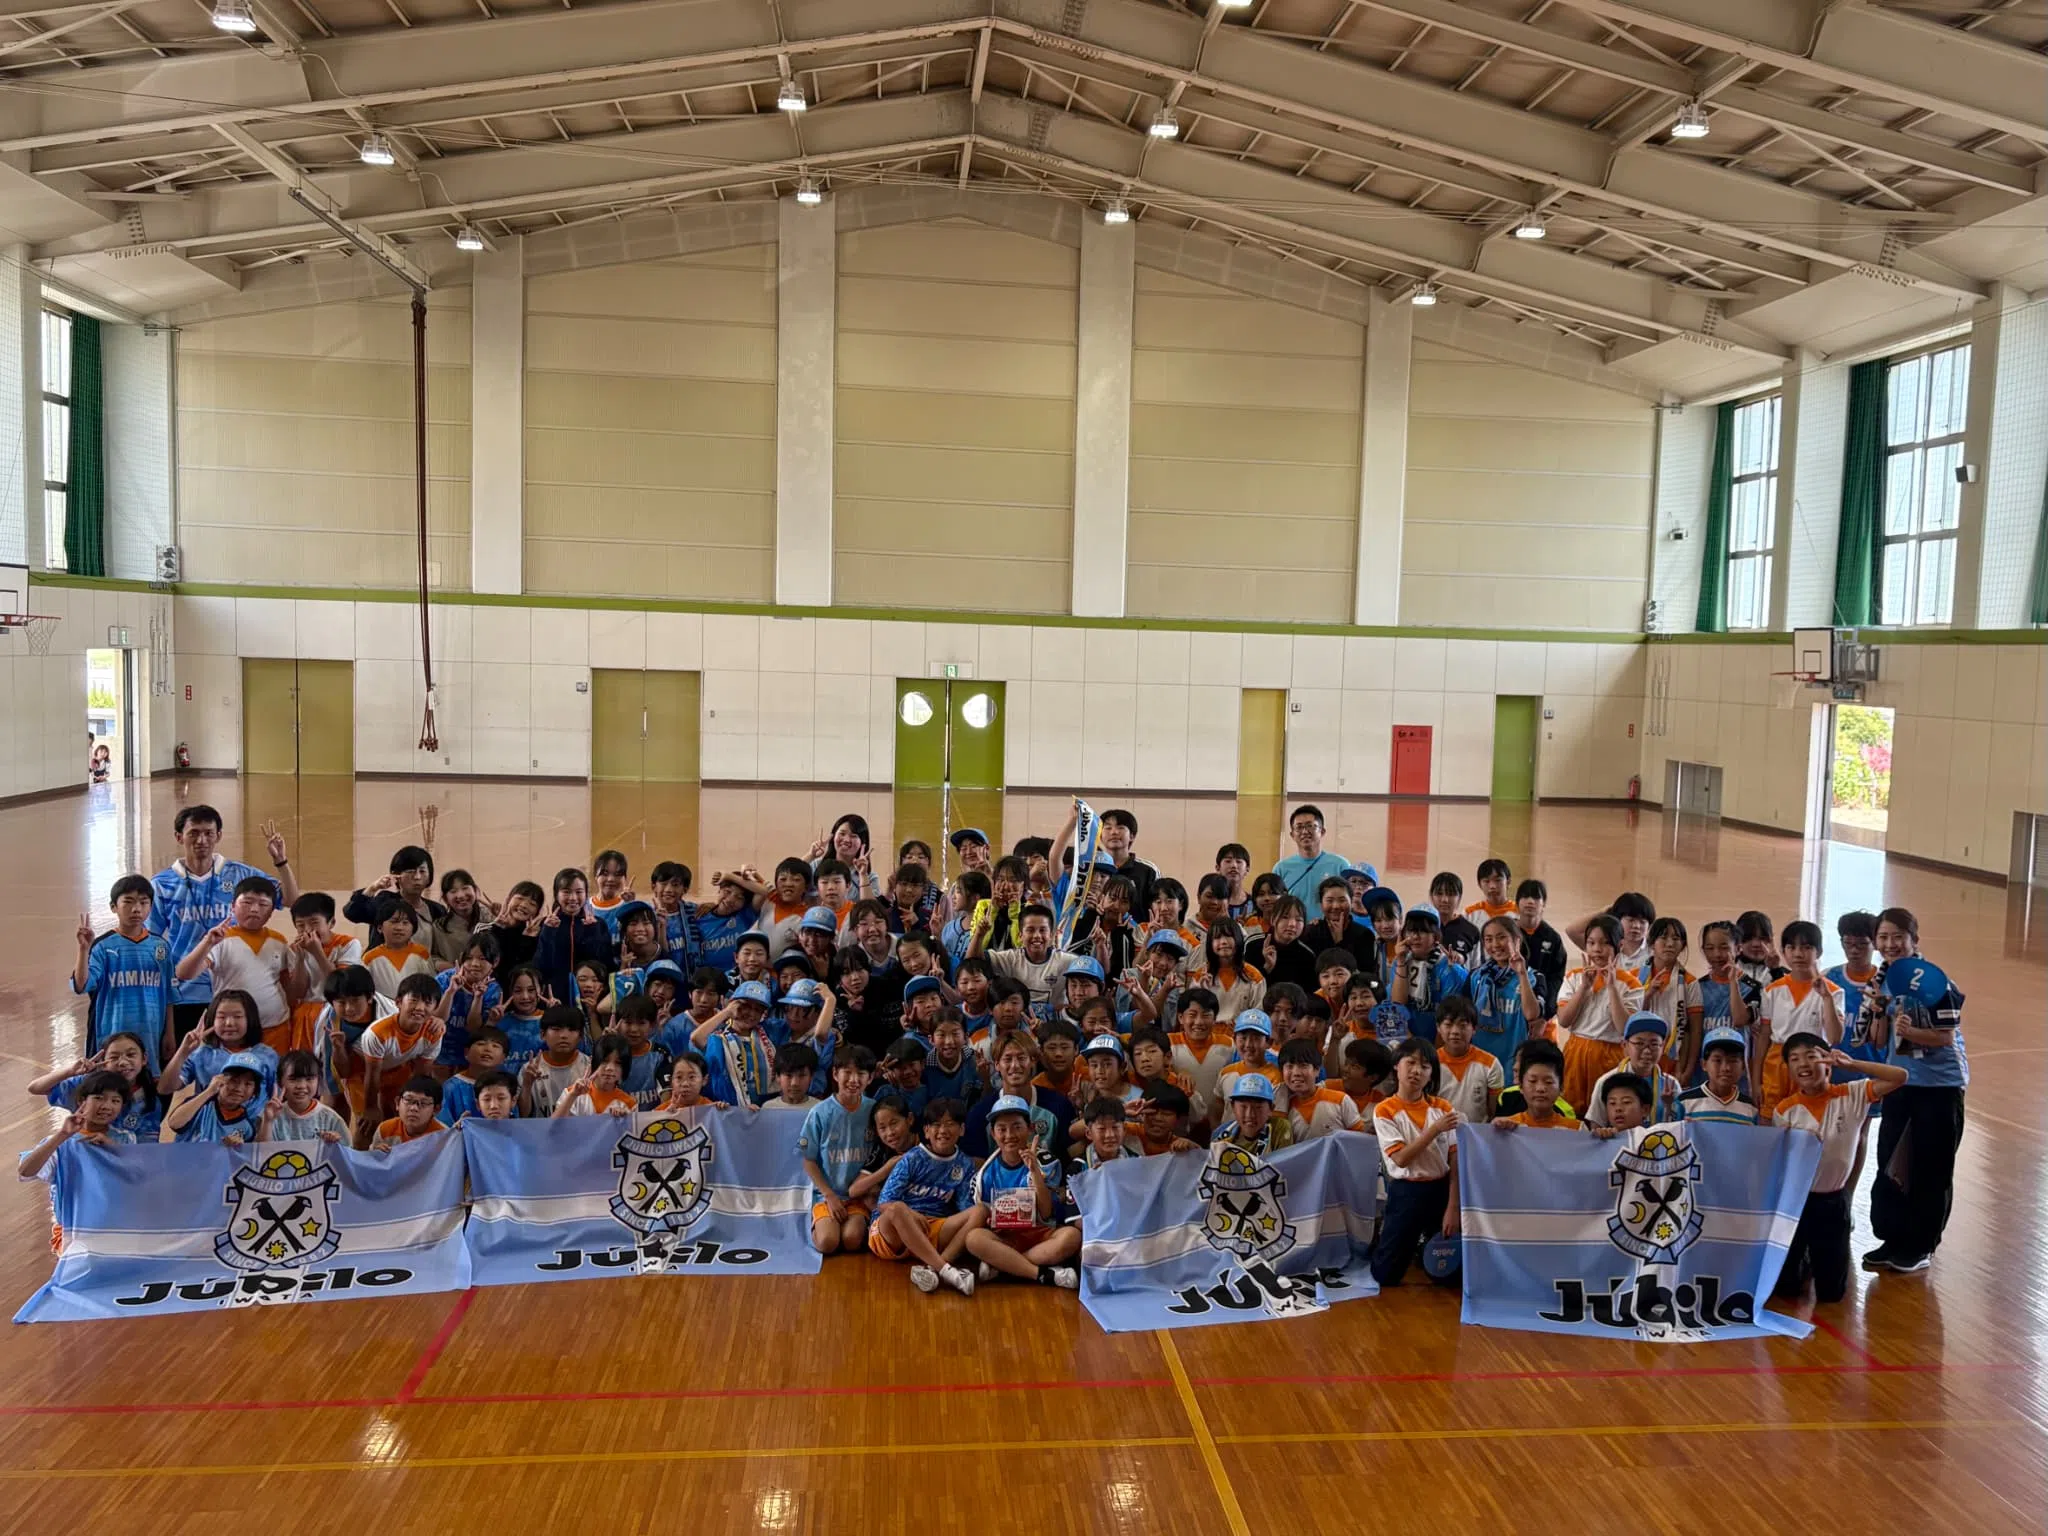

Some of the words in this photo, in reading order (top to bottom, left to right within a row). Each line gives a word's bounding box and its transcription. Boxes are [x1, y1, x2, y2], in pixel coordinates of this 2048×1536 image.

[108, 969, 160, 988] YAMAHA
[1410, 966, 1419, 988] 2
[1910, 967, 1924, 986] 2
